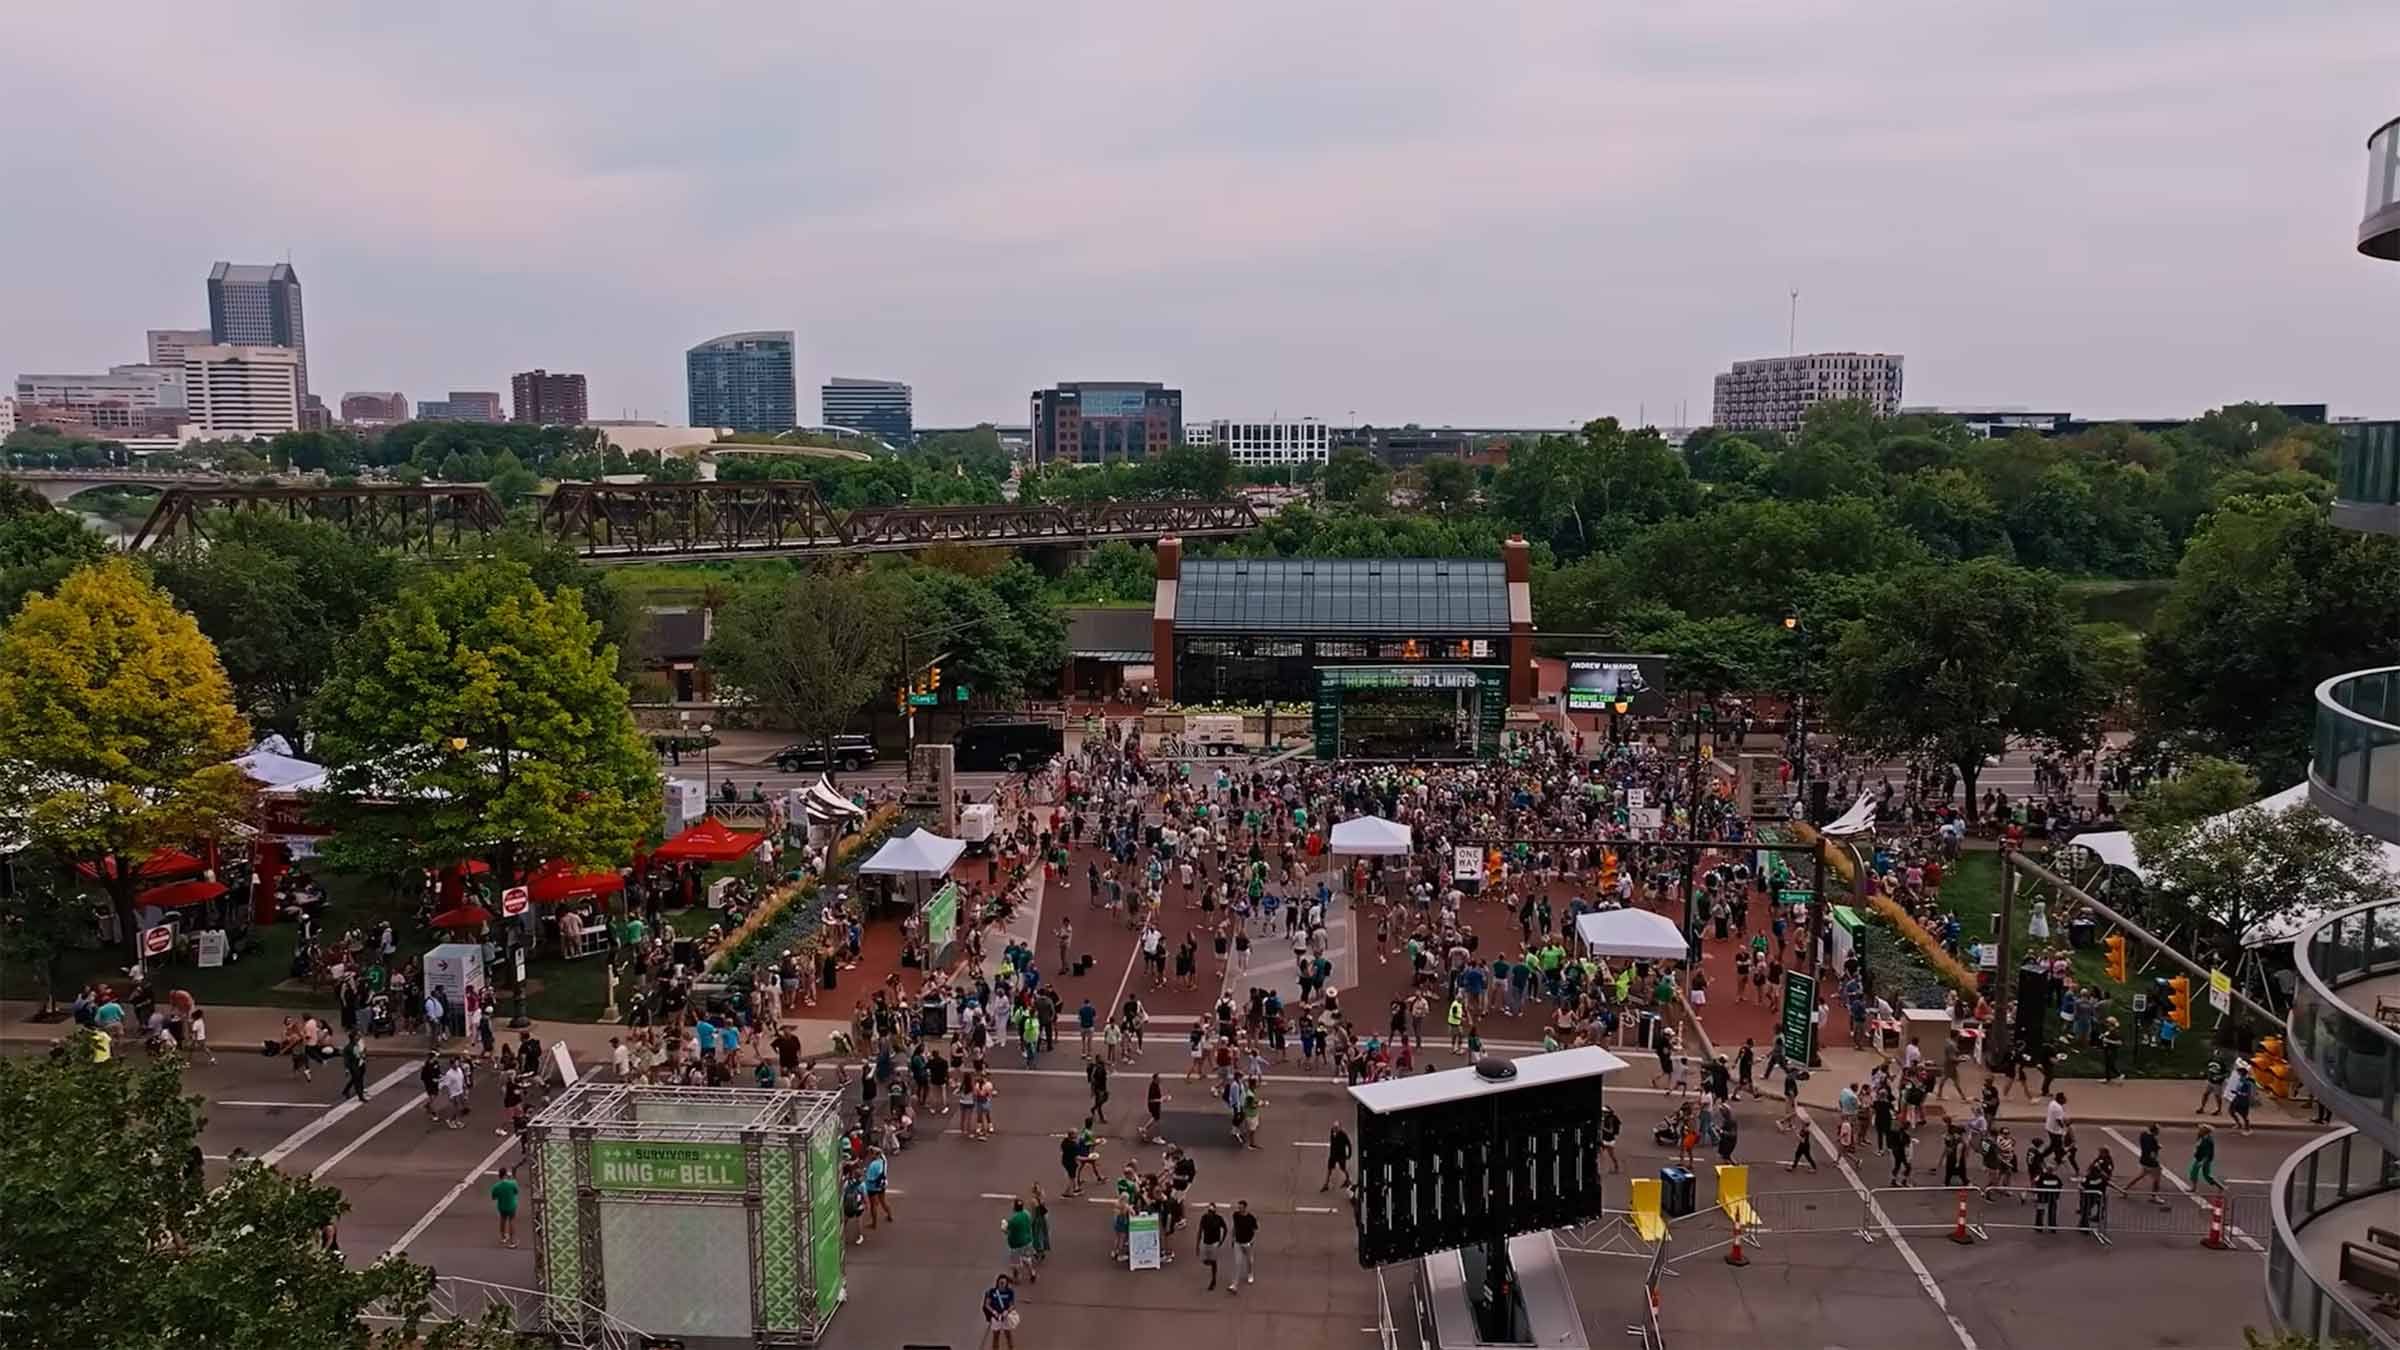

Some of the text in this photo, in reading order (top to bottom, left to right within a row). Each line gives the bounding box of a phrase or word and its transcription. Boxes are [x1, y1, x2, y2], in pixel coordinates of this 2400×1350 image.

[1346, 674, 1379, 688] HOPE
[1383, 674, 1409, 688] HAS
[1412, 674, 1430, 688] NO
[1434, 673, 1476, 688] LIMITS
[1458, 849, 1479, 858] ONE
[1458, 858, 1480, 867] WAY
[634, 1148, 700, 1161] SURVIVORS
[604, 1162, 735, 1185] RING THE BELL
